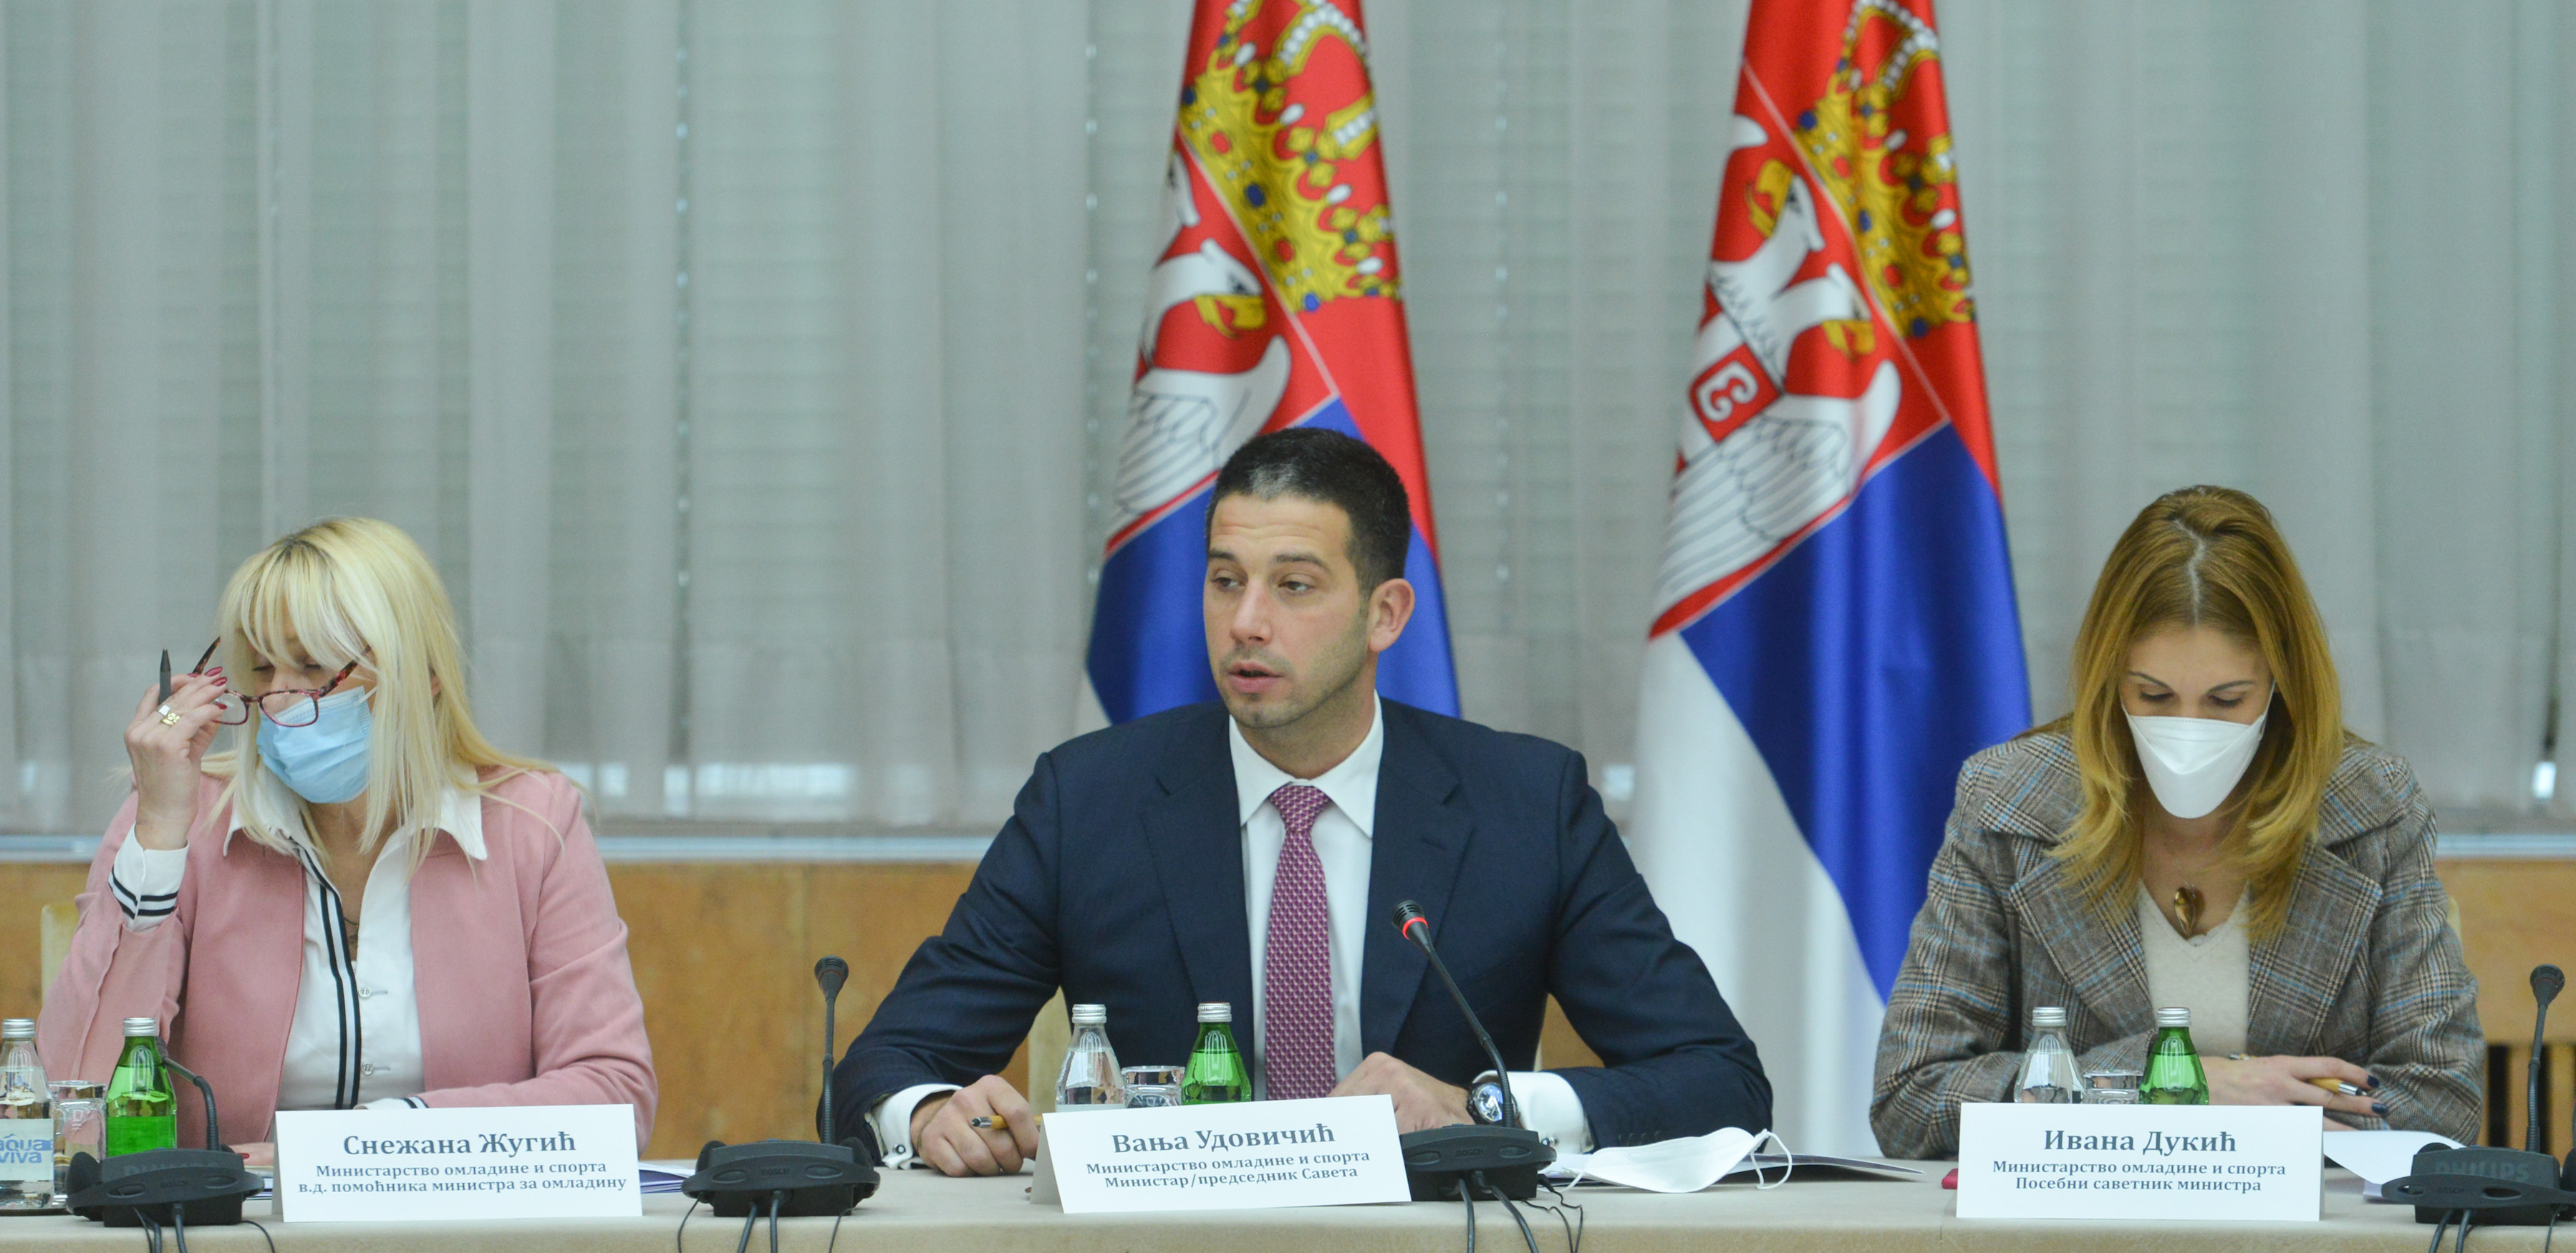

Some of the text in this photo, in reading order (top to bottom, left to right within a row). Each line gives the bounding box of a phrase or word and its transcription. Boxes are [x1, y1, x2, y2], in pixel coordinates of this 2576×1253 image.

[344, 1131, 576, 1158] Снежана Жугић
[1111, 1123, 1335, 1153] Вања Удовичић
[2045, 1131, 2236, 1156] Ивана Дукић
[317, 1166, 439, 1179] Министарство
[445, 1166, 529, 1176] омладине
[549, 1164, 606, 1176] спорта
[1087, 1162, 1207, 1174] Министарство
[1212, 1157, 1293, 1169] омладине
[1314, 1152, 1369, 1165] спорта
[1993, 1161, 2117, 1176] Министарство
[2122, 1164, 2207, 1175] омладине
[2228, 1166, 2285, 1177] спорта
[299, 1184, 327, 1194] в.д.
[332, 1181, 427, 1192] помоћника
[433, 1181, 515, 1193] министра
[542, 1179, 626, 1191] омладину
[1105, 1169, 1357, 1188] Министар/председник Савета
[2017, 1177, 2260, 1194] Посебни саветник министра
